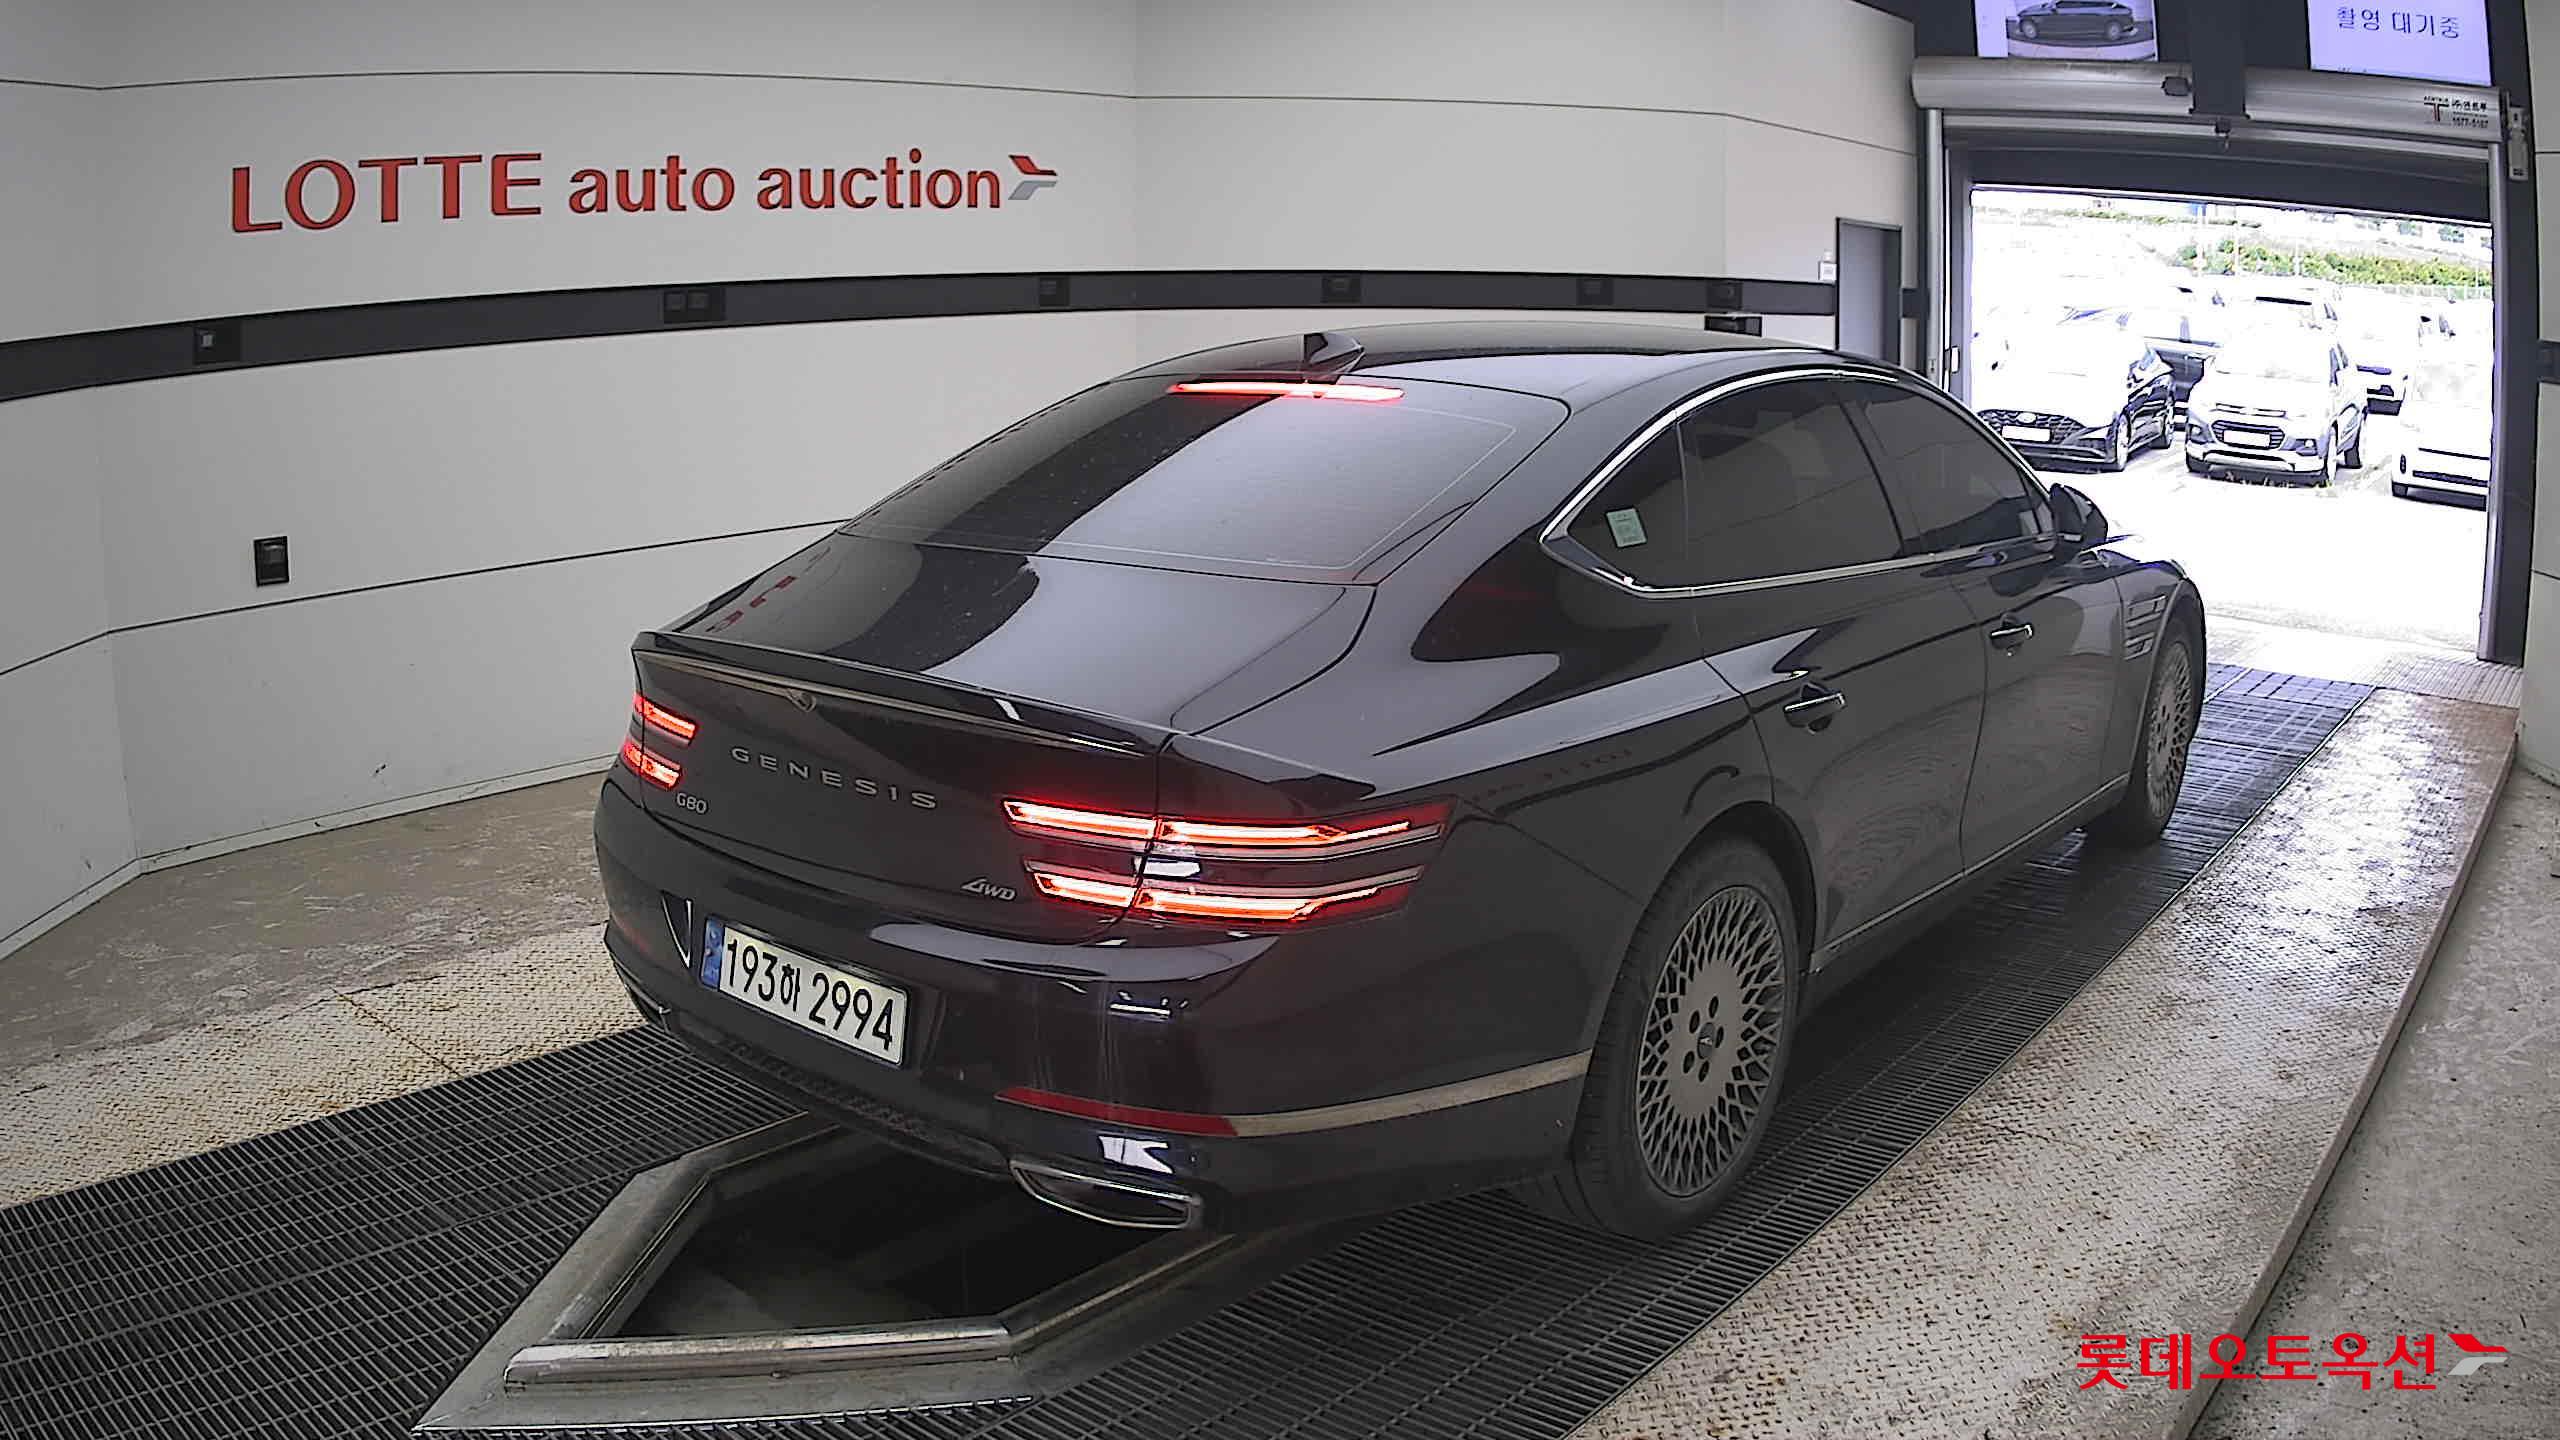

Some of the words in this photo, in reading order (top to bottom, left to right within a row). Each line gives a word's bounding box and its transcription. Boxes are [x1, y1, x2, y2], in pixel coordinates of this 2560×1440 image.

[2338, 6, 2380, 32] 촬영
[2391, 11, 2460, 39] 대기중
[231, 152, 543, 233] LOTTE
[568, 154, 736, 214] auto
[756, 147, 1002, 210] auction
[730, 746, 937, 810] GENESIS
[675, 792, 708, 815] G80
[960, 877, 1017, 901] 4WD
[726, 938, 802, 1013] 193하
[808, 971, 894, 1051] 2994
